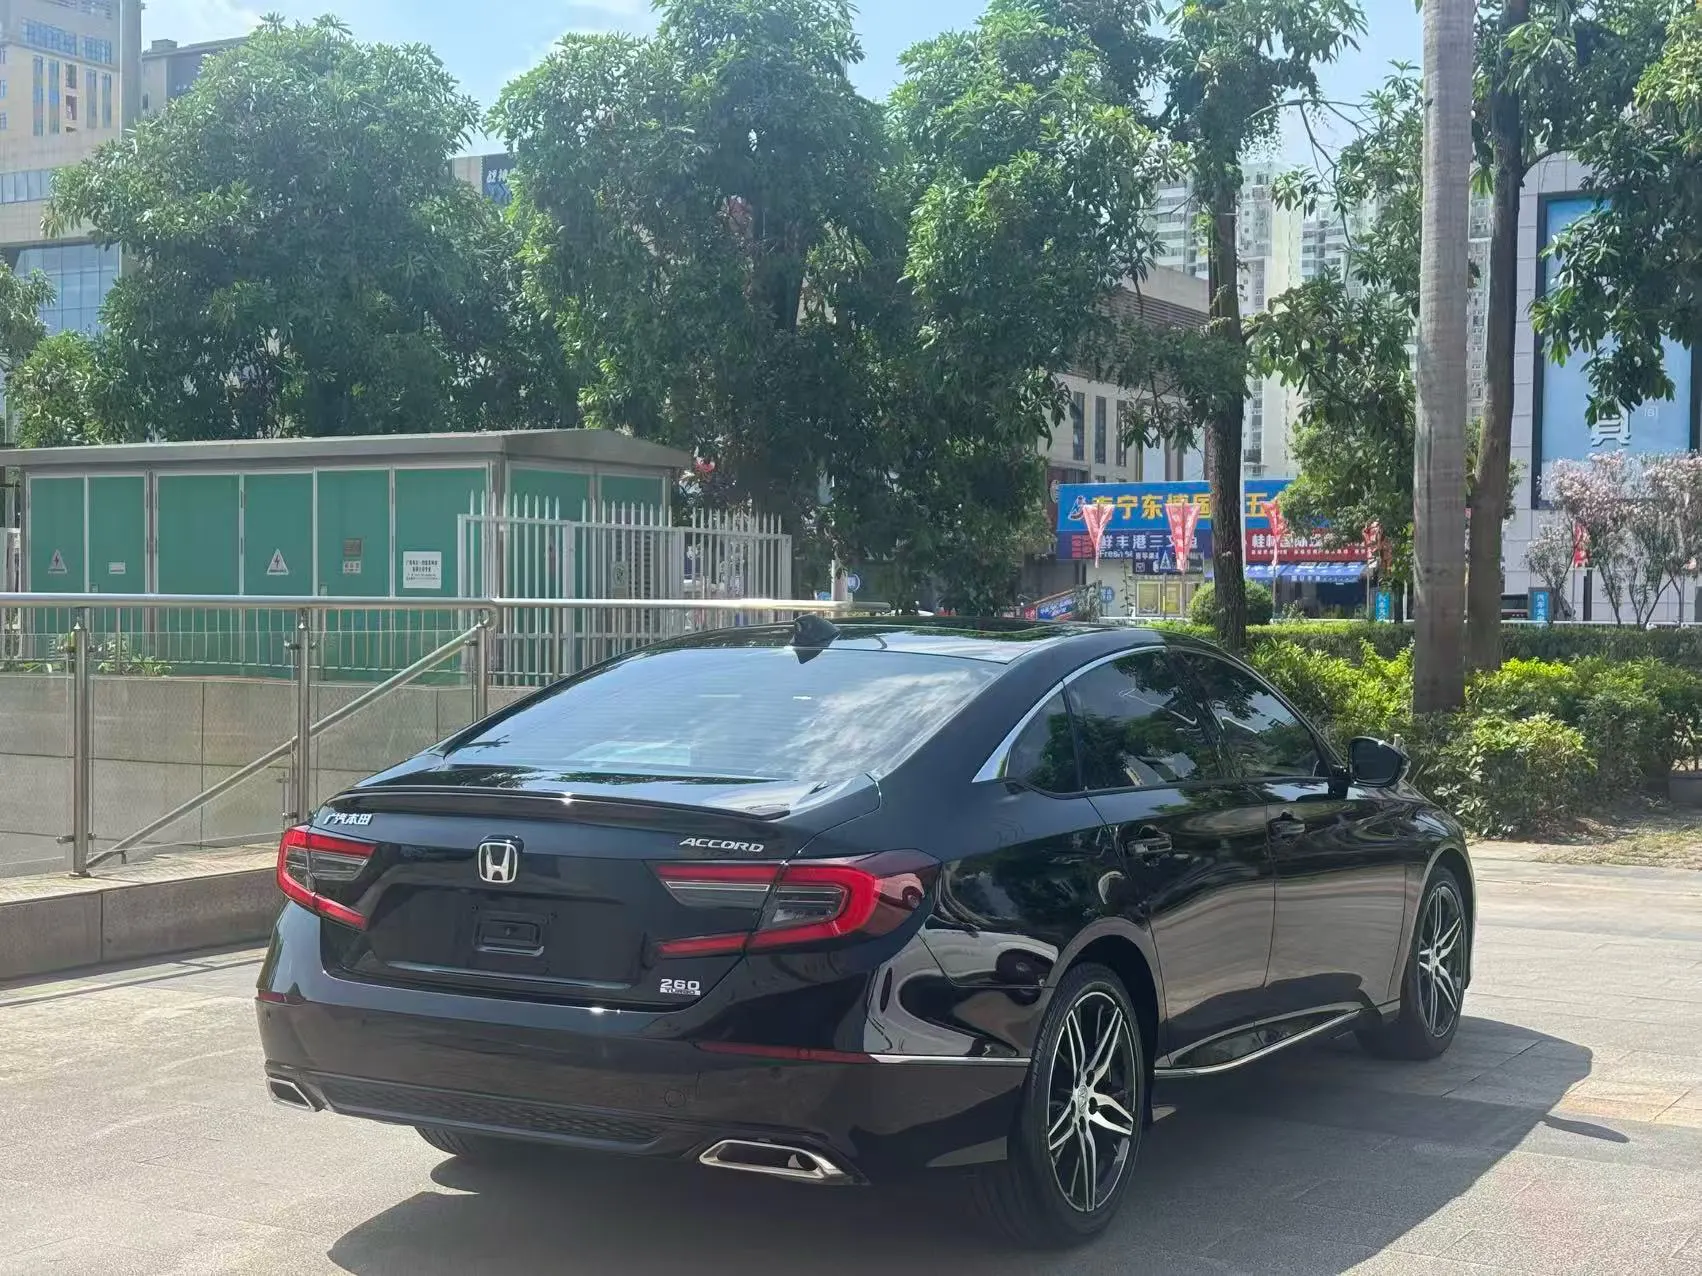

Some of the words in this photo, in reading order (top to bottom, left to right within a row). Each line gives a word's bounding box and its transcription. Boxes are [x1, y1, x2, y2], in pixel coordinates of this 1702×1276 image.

[323, 812, 373, 826] 广汽本田
[679, 838, 765, 852] ACCORD
[660, 978, 700, 990] 260
